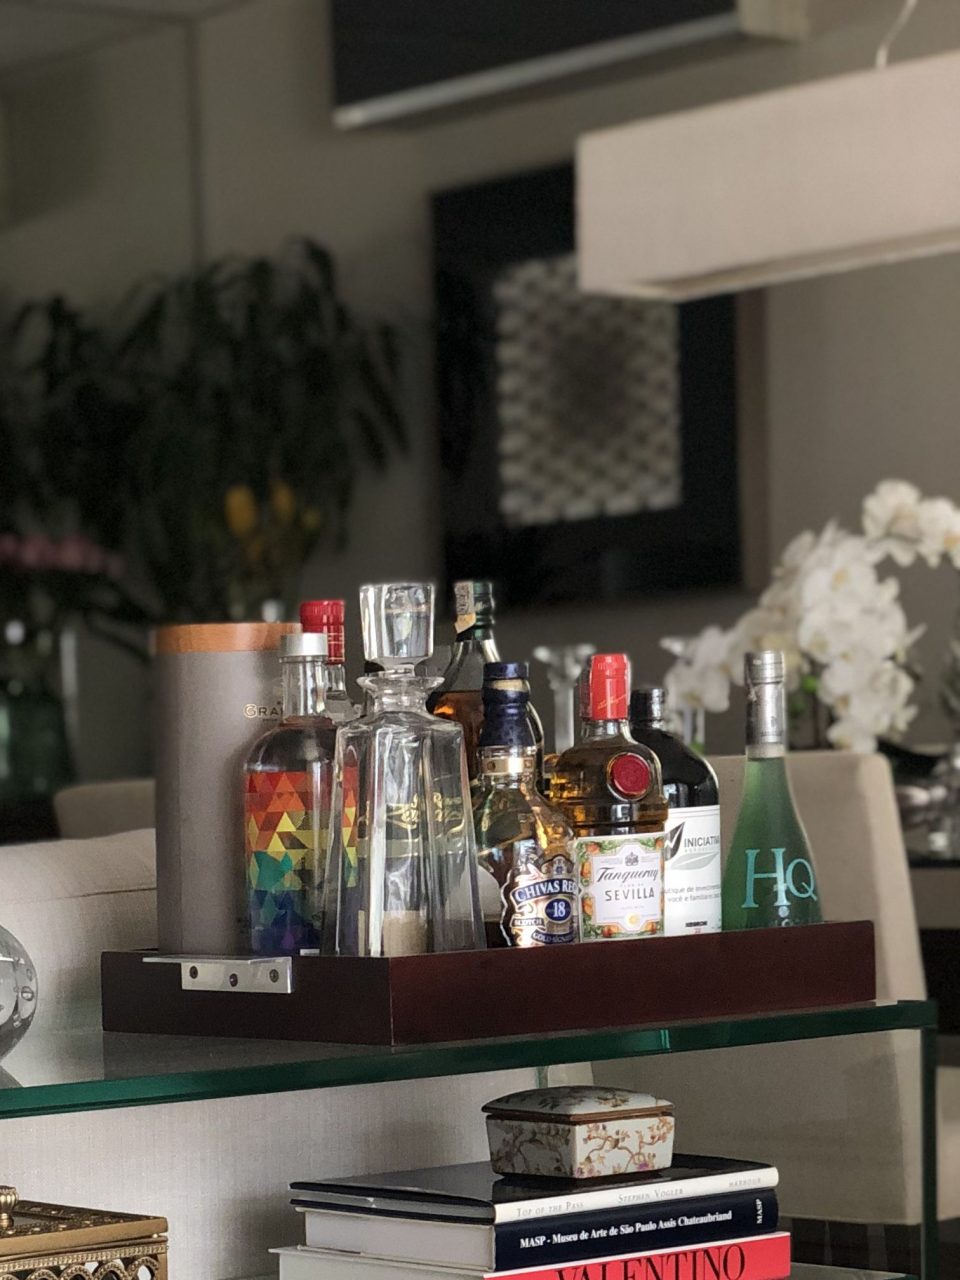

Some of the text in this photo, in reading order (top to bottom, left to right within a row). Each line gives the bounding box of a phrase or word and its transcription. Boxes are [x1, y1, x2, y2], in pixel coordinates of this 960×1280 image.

[243, 703, 283, 718] GRA
[597, 866, 659, 883] Tanqueray
[514, 880, 560, 902] CHIVAS
[605, 887, 655, 902] SEVILLA
[553, 901, 566, 918] 18
[520, 1235, 546, 1249] MASP
[552, 1233, 578, 1245] Museu
[579, 1230, 589, 1240] de
[590, 1229, 607, 1239] Arte
[608, 1226, 618, 1236] de
[620, 1223, 634, 1235] São
[635, 1220, 657, 1232] Paulo
[658, 1218, 677, 1230] Assis
[678, 1210, 732, 1226] Chateaubriand
